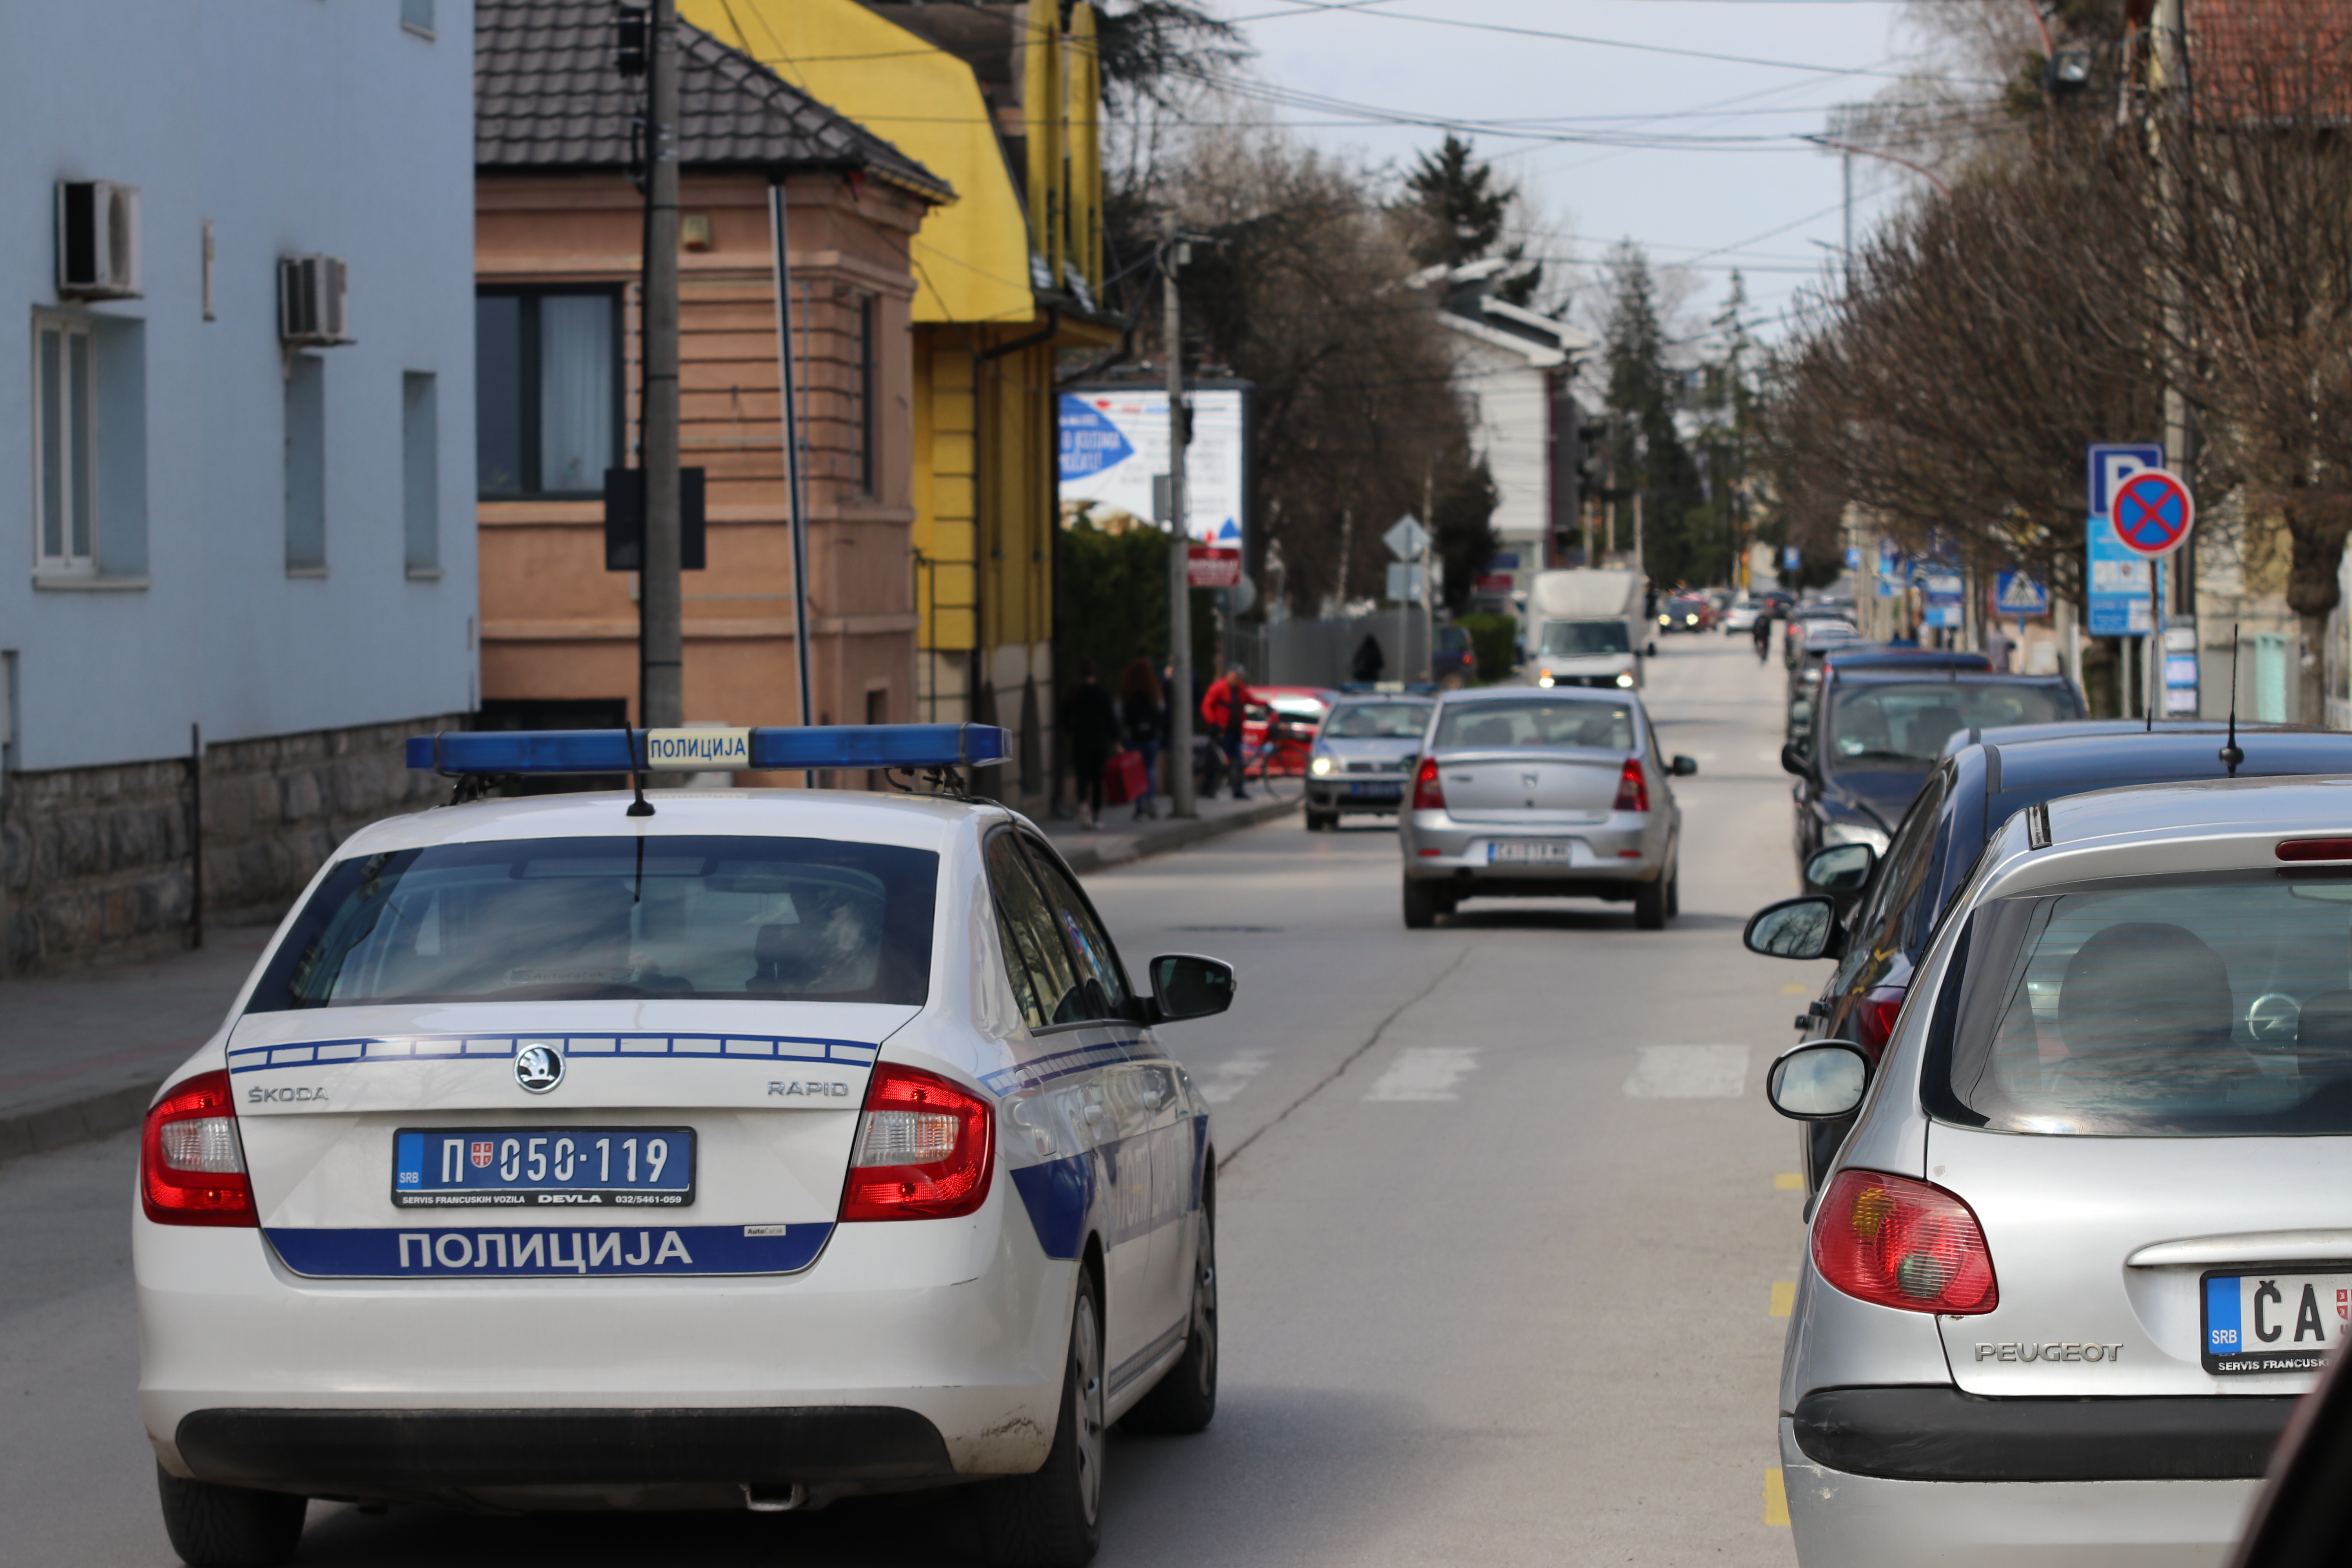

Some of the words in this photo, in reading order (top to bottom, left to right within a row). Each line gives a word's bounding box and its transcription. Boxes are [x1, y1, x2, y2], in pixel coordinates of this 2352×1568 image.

[651, 738, 746, 761] ПОЛИЦИЈА
[248, 1085, 328, 1103] ŠKODA
[768, 1081, 849, 1096] RAPID
[442, 1139, 465, 1183] П
[399, 1172, 419, 1183] SRB
[403, 1196, 434, 1204] SERVIS
[436, 1196, 492, 1204] FRANCUSKIH
[538, 1194, 602, 1203] DEVLA
[399, 1231, 693, 1273] ПОЛИЦИЈА
[2254, 1280, 2325, 1342] ČA
[2212, 1330, 2238, 1344] SRB
[1975, 1343, 2123, 1362] PEUGEOT
[2218, 1361, 2260, 1371] SERVIS
[2263, 1358, 2330, 1369] FRANCUSKI
